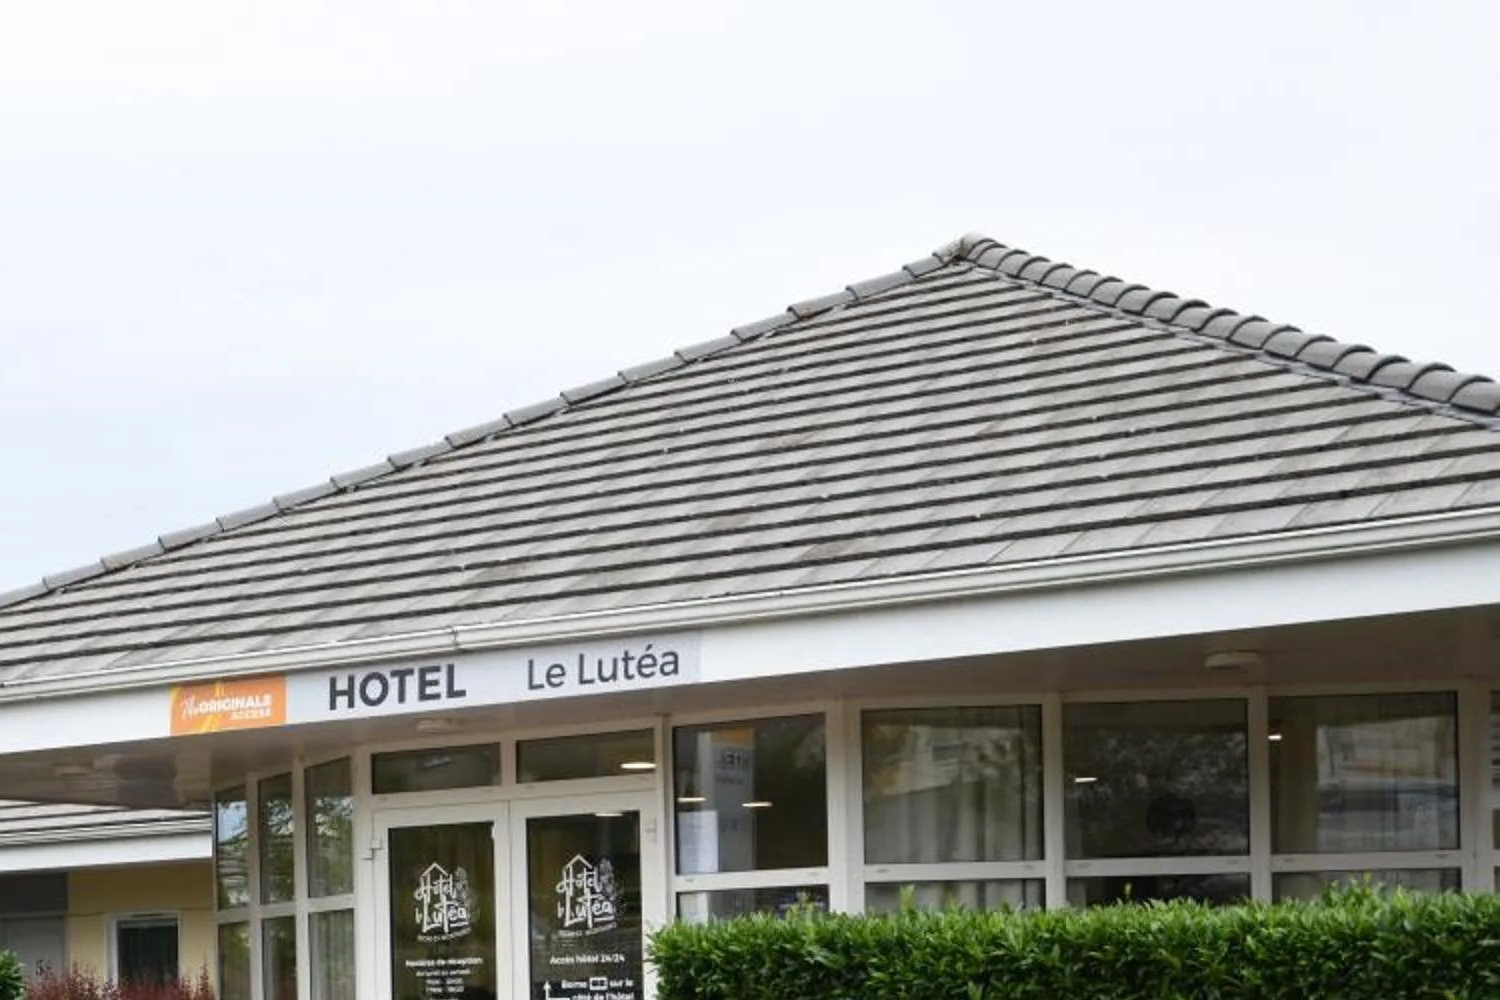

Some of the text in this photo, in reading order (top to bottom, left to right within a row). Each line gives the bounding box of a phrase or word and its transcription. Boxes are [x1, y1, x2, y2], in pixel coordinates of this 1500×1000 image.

[328, 644, 680, 711] HOTEL Le Lutéa
[198, 693, 272, 714] ORIGINALS
